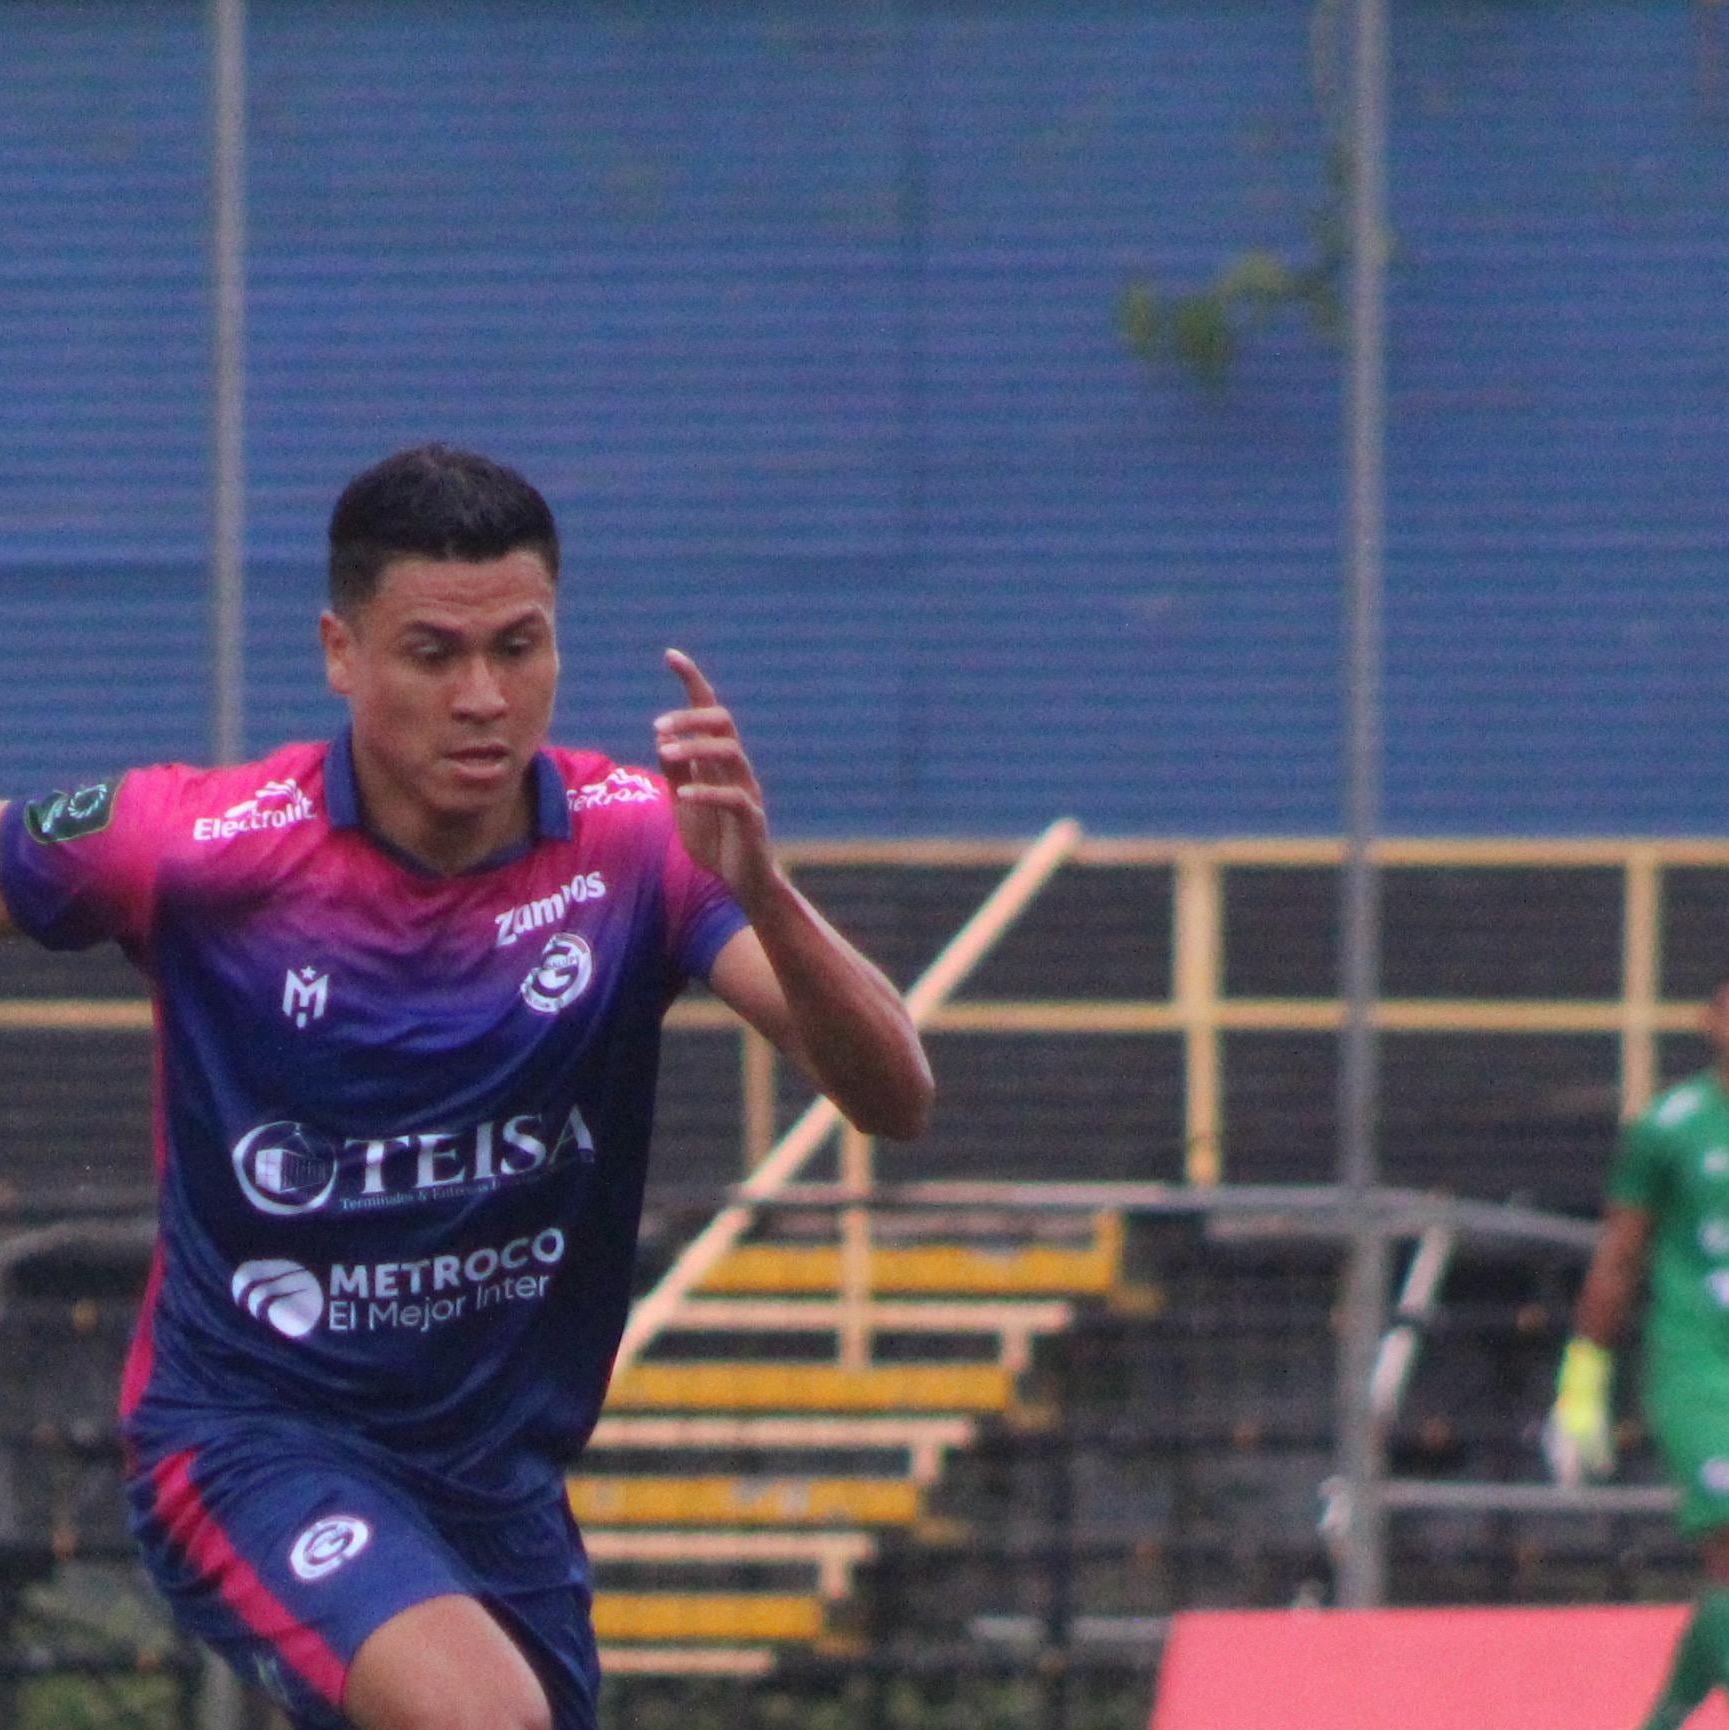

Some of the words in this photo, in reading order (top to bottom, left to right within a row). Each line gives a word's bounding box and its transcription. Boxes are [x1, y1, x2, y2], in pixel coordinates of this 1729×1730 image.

[344, 1103, 596, 1196] TEISA
[330, 1227, 565, 1299] METROCO
[329, 1301, 357, 1332] El
[369, 1295, 467, 1335] Mejor
[476, 1273, 551, 1311] Inter
